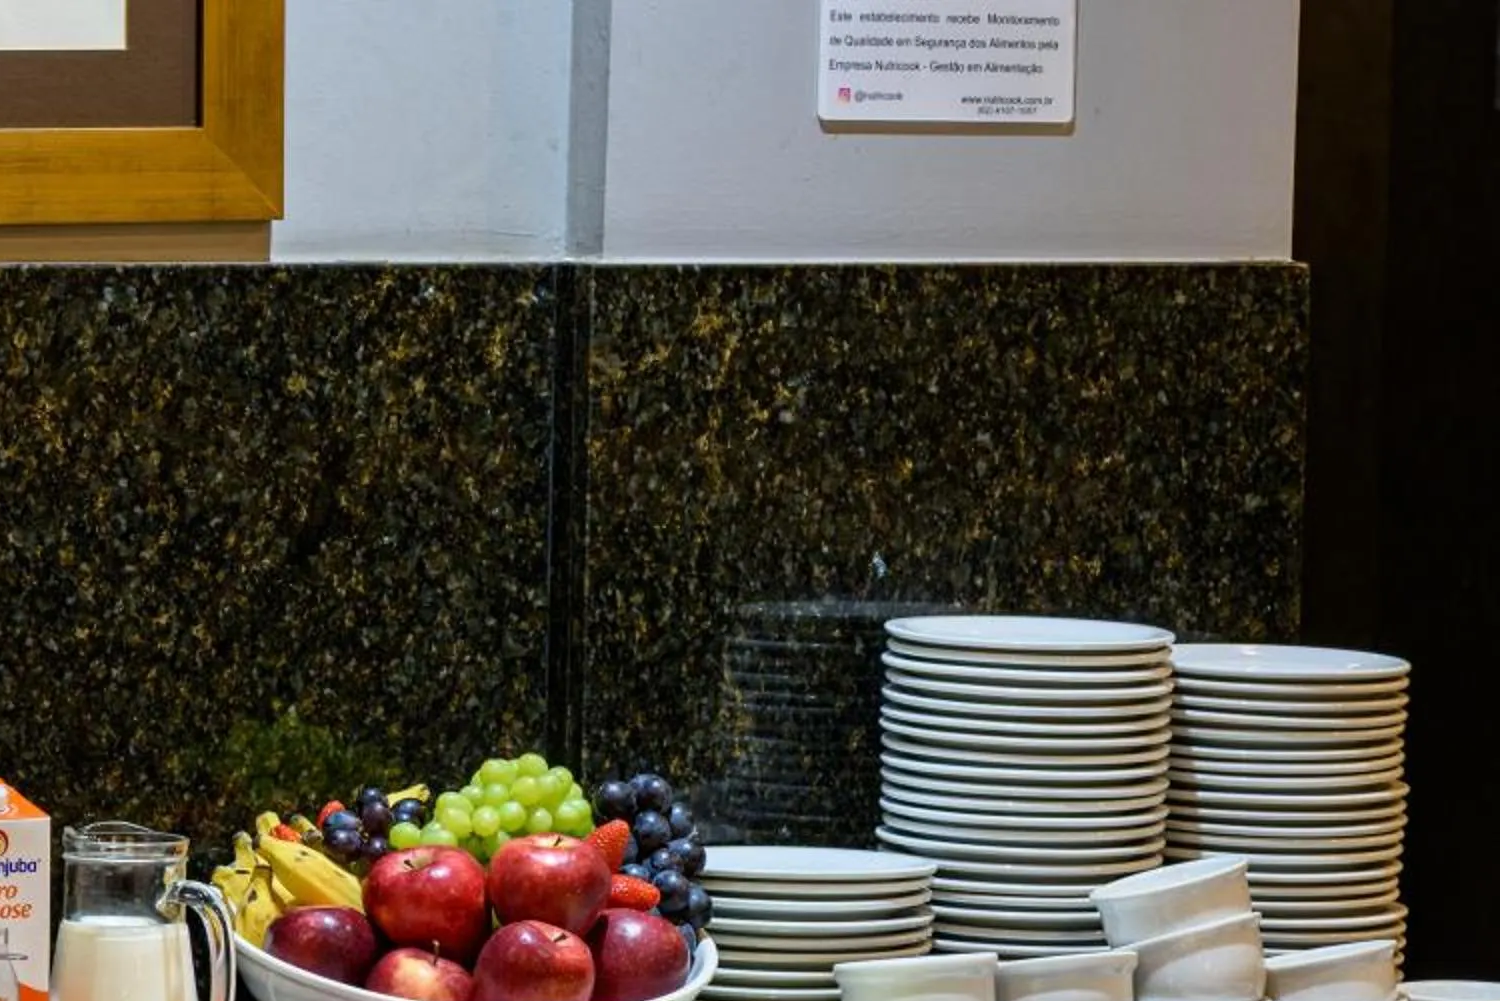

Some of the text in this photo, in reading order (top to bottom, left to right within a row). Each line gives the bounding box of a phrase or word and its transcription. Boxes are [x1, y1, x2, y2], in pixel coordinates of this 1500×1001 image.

[829, 9, 1060, 26] Este estabelecimento recebe Monitoramento
[829, 34, 1059, 51] de Qualidade em Segurança dos Alimentos pela
[828, 59, 873, 72] Empresa
[967, 63, 982, 73] em
[984, 61, 1044, 75] Alimentação
